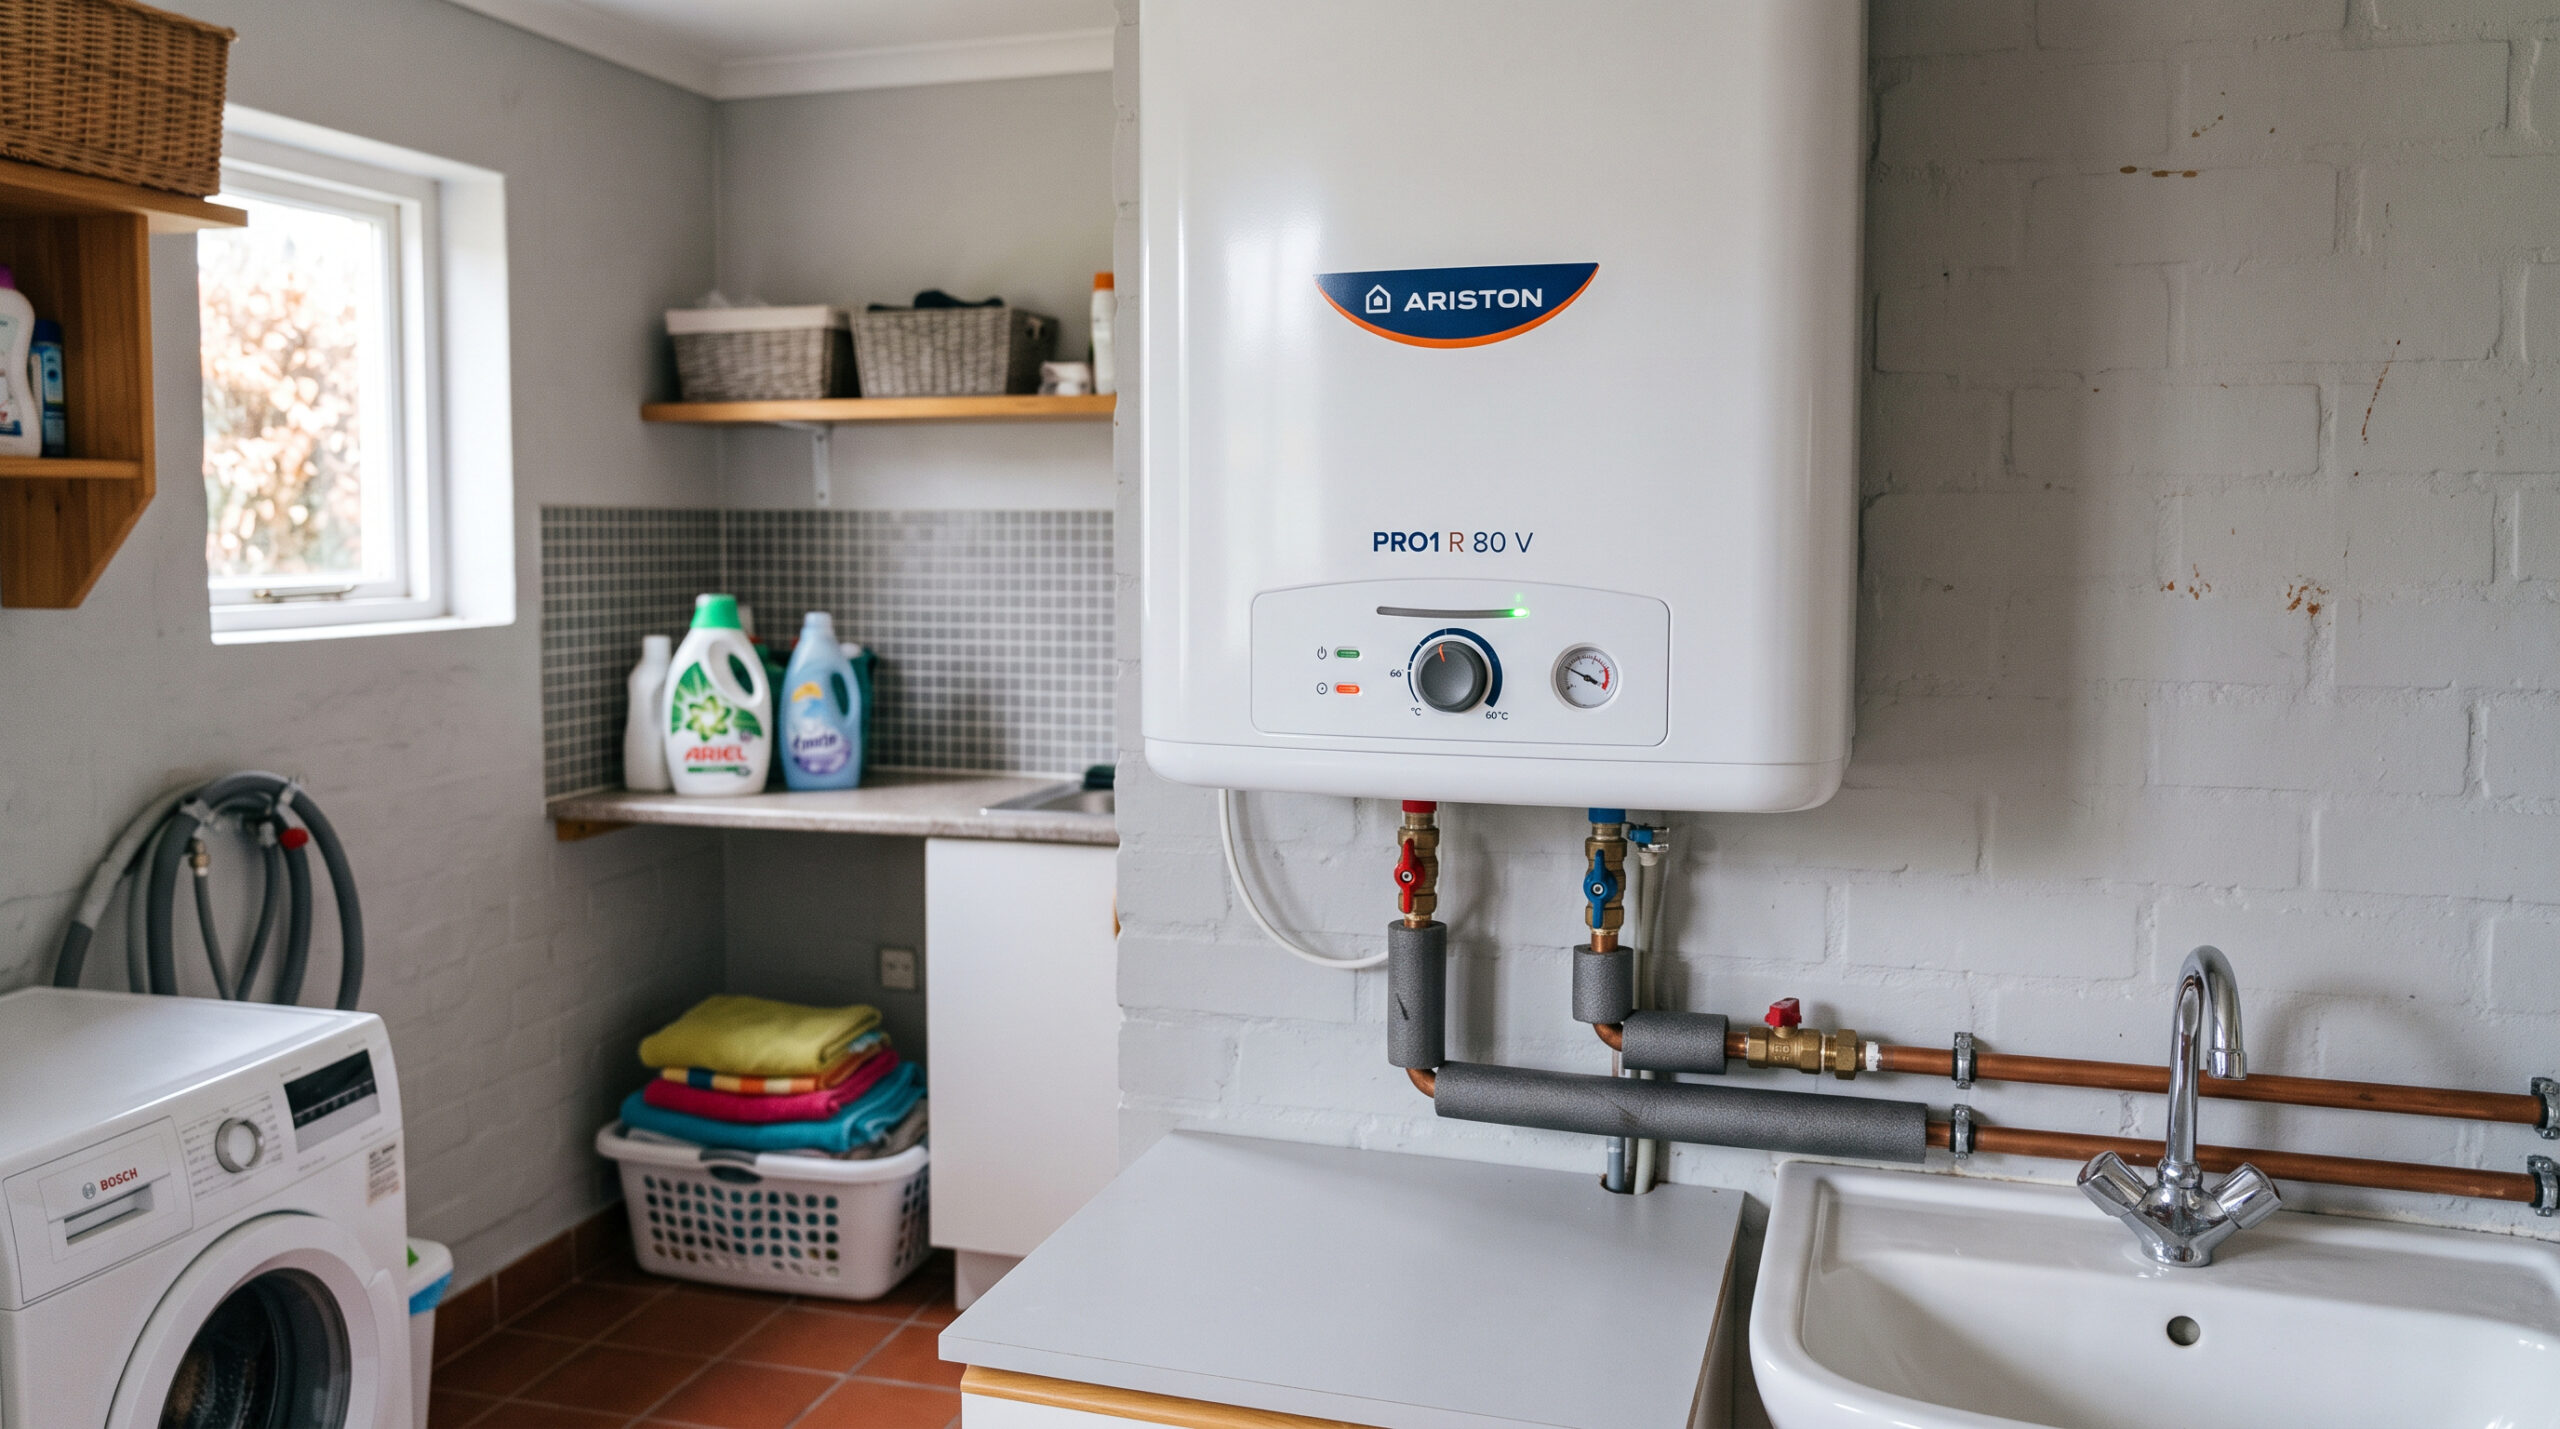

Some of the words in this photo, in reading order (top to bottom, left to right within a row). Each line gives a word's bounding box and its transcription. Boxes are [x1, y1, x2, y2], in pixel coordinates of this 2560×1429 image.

[1403, 288, 1543, 312] ARISTON
[1373, 531, 1439, 553] PRO1
[1450, 532, 1464, 553] R
[1473, 531, 1507, 553] 80
[1514, 532, 1534, 553] V
[684, 745, 747, 762] ARIEL
[100, 1167, 138, 1192] BOSCH
